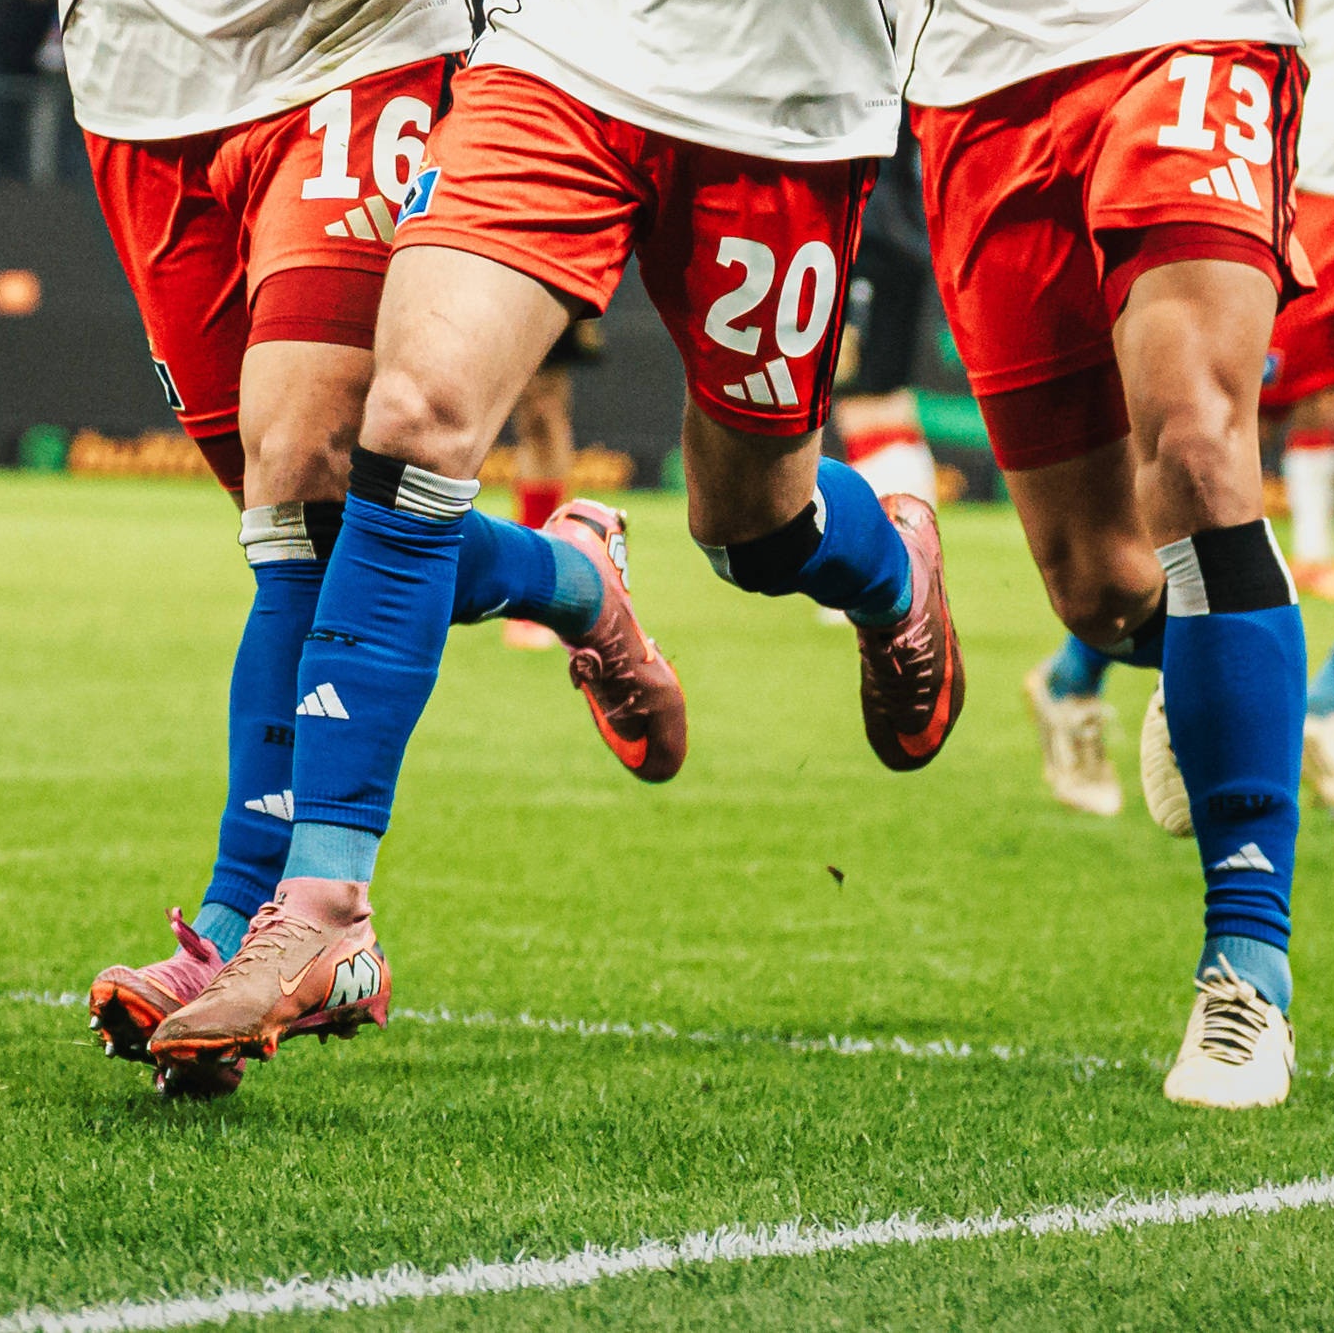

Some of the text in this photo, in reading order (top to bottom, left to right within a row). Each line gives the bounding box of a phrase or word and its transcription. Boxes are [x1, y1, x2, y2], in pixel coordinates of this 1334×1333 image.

[301, 89, 432, 205] 16
[1157, 54, 1273, 166] 13
[704, 236, 837, 359] 20
